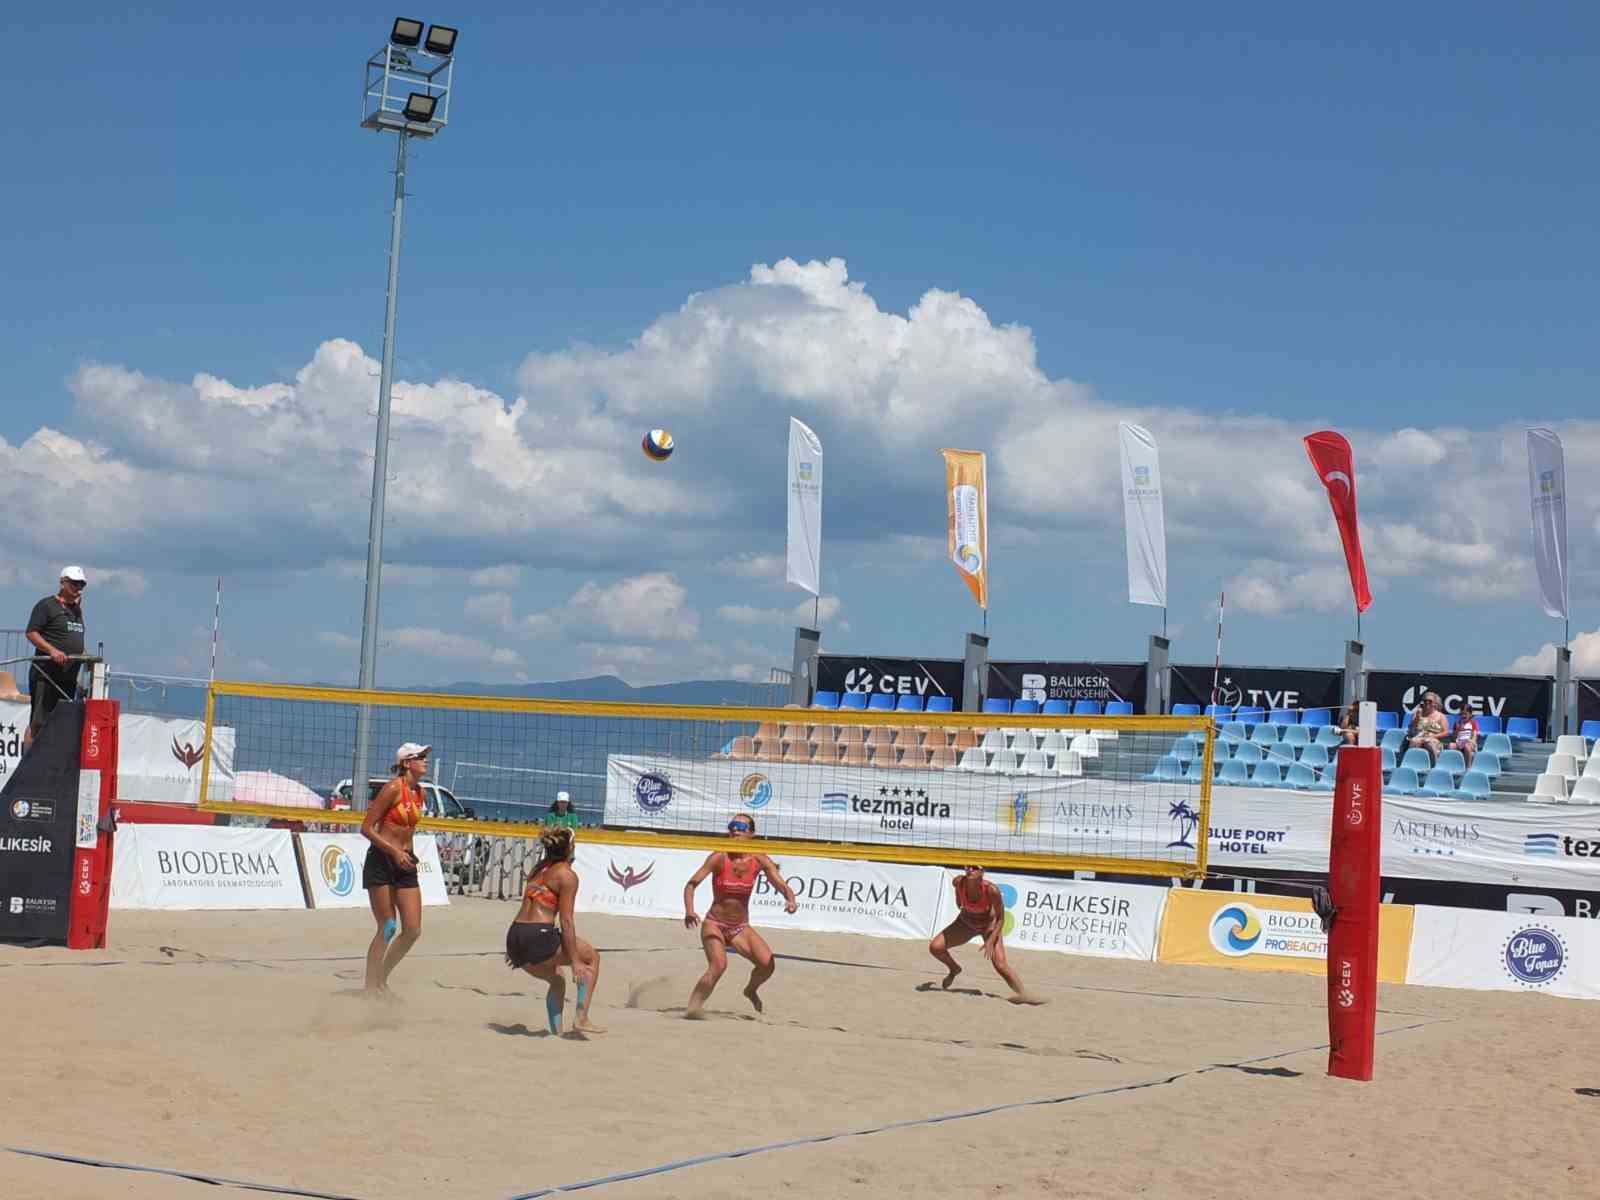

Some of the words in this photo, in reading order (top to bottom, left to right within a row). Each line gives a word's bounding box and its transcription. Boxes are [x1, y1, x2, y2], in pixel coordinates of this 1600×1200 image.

[880, 675, 929, 695] CEV
[1247, 689, 1300, 709] TVF
[1444, 694, 1507, 717] CEV
[851, 794, 951, 818] tezmadra
[1351, 783, 1362, 808] TVF
[1056, 801, 1134, 819] ARTEMIS
[880, 816, 914, 830] hotel
[1392, 819, 1480, 841] ARTEMIS
[1207, 828, 1242, 840] BLUE
[1245, 830, 1286, 842] PORT
[1220, 841, 1268, 854] HOTEL
[157, 850, 280, 876] BIODERMA
[1025, 891, 1130, 917] BALIKESİR
[1022, 911, 1128, 937] BÜYÜKŞEHİR
[1510, 937, 1548, 959] Blue
[1342, 960, 1351, 988] CEV
[1524, 955, 1559, 973] Topaz
